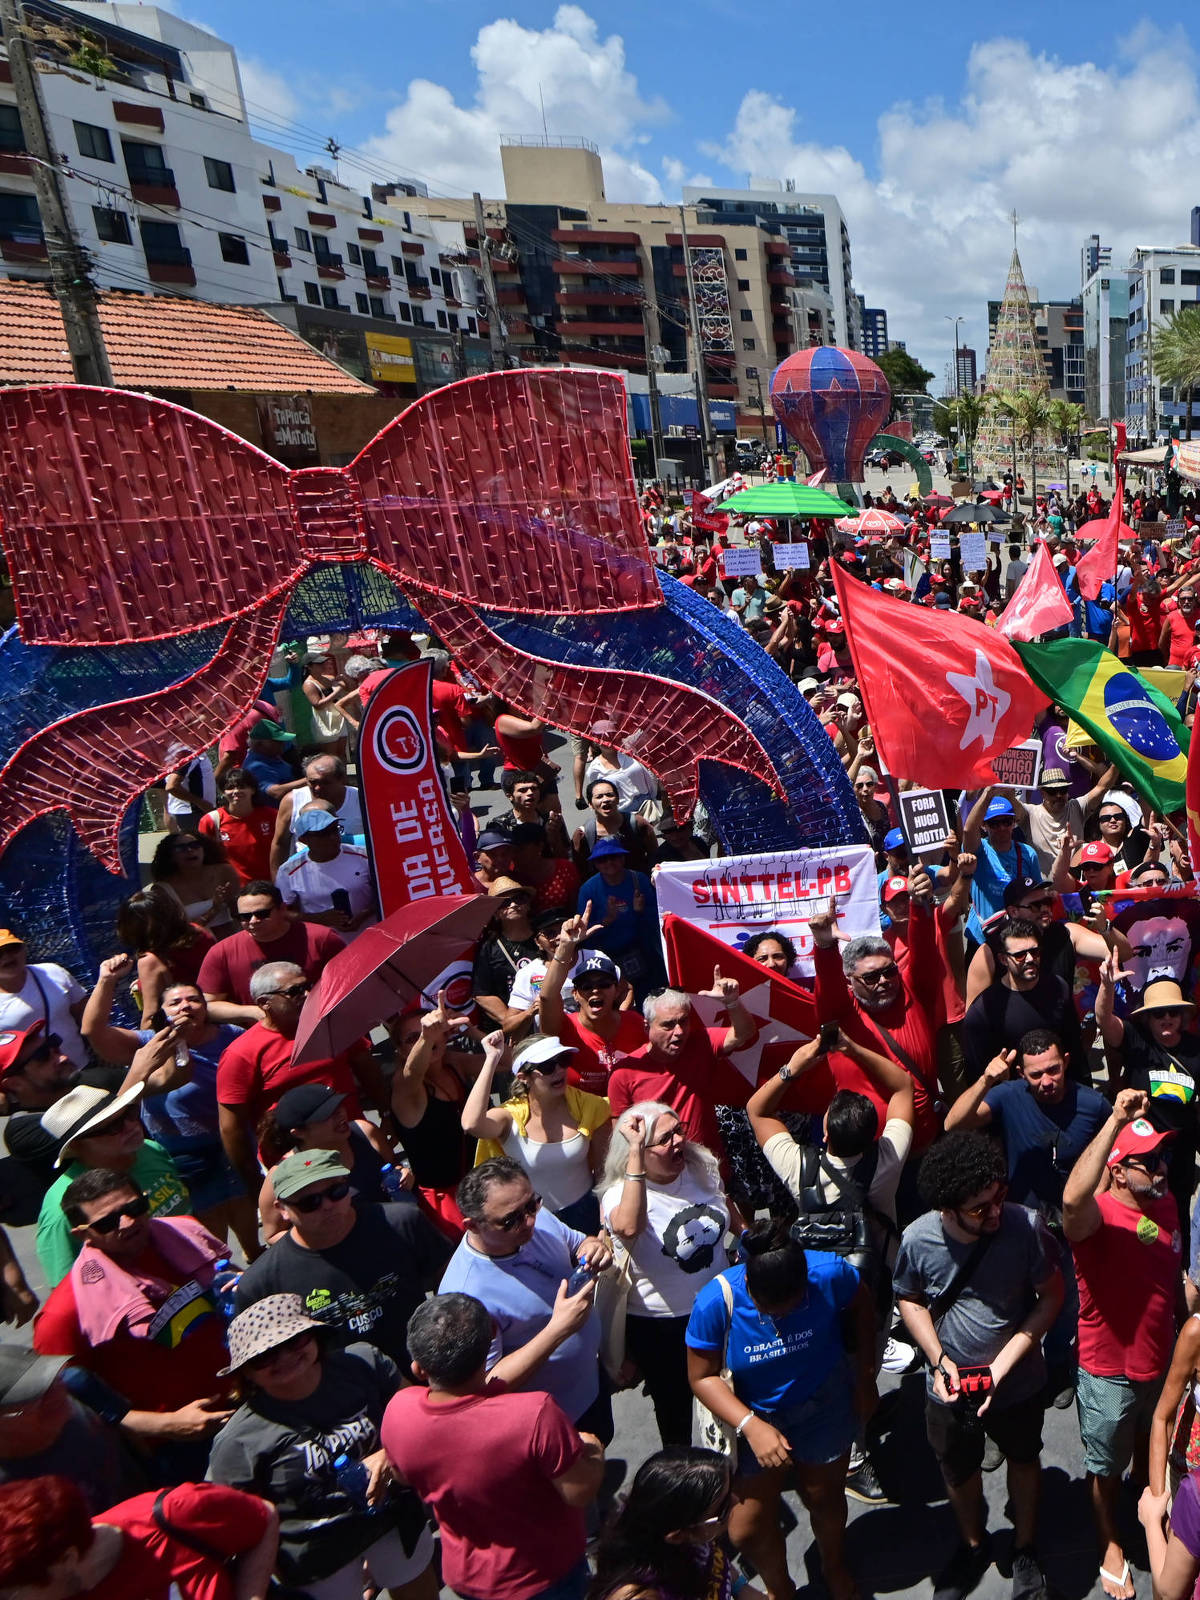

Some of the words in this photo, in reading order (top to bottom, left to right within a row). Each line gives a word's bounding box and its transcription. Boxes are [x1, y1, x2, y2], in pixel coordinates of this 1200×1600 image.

[975, 687, 998, 722] PT
[1000, 750, 1034, 761] NGRESSO
[1003, 773, 1031, 785] POVO
[911, 796, 936, 812] FORA
[390, 799, 424, 844] DE
[914, 812, 939, 828] HUGO
[914, 829, 946, 845] MOTTA
[402, 852, 437, 901] DA
[692, 865, 851, 904] SINTTEL-PB
[150, 1185, 175, 1211] ASIL
[348, 1306, 383, 1331] CUSCO
[744, 1346, 751, 1354] O
[753, 1338, 784, 1353] BRASIL
[787, 1332, 794, 1344] É
[795, 1328, 813, 1341] DOS
[749, 1341, 809, 1363] BRASILEIROS
